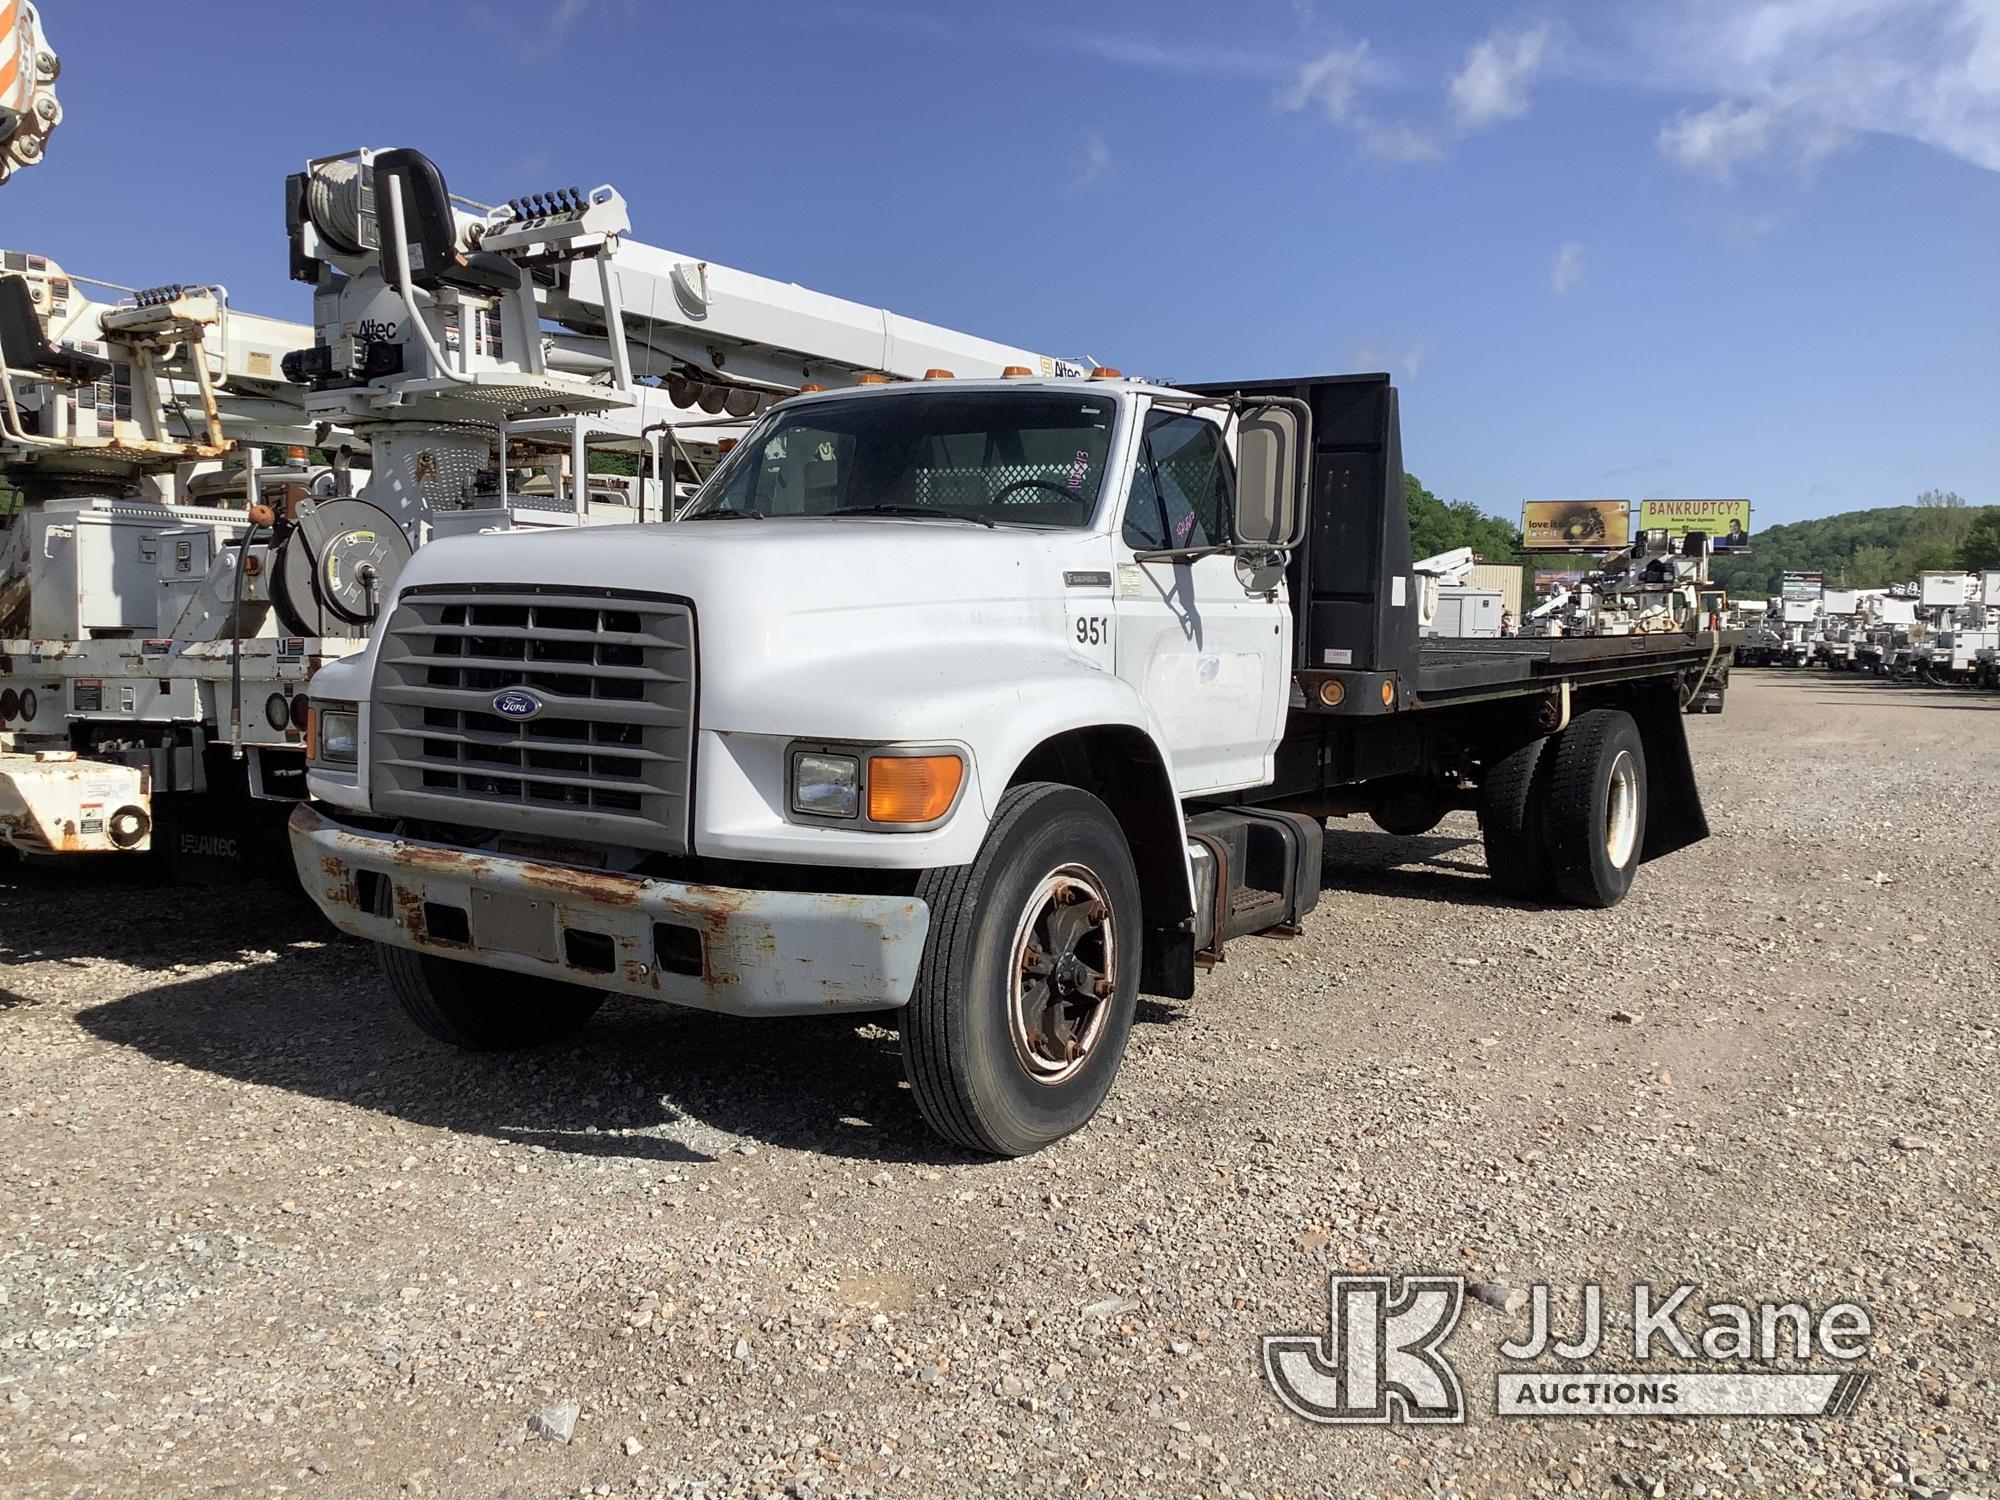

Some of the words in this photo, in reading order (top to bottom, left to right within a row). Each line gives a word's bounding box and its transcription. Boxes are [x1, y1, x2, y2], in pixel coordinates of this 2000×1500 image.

[359, 318, 397, 340] Altec
[1649, 502, 1740, 515] BANKRUPTCY?
[1529, 520, 1549, 528] love
[1550, 519, 1558, 528] it
[1076, 616, 1107, 646] 951
[502, 696, 528, 712] Ford
